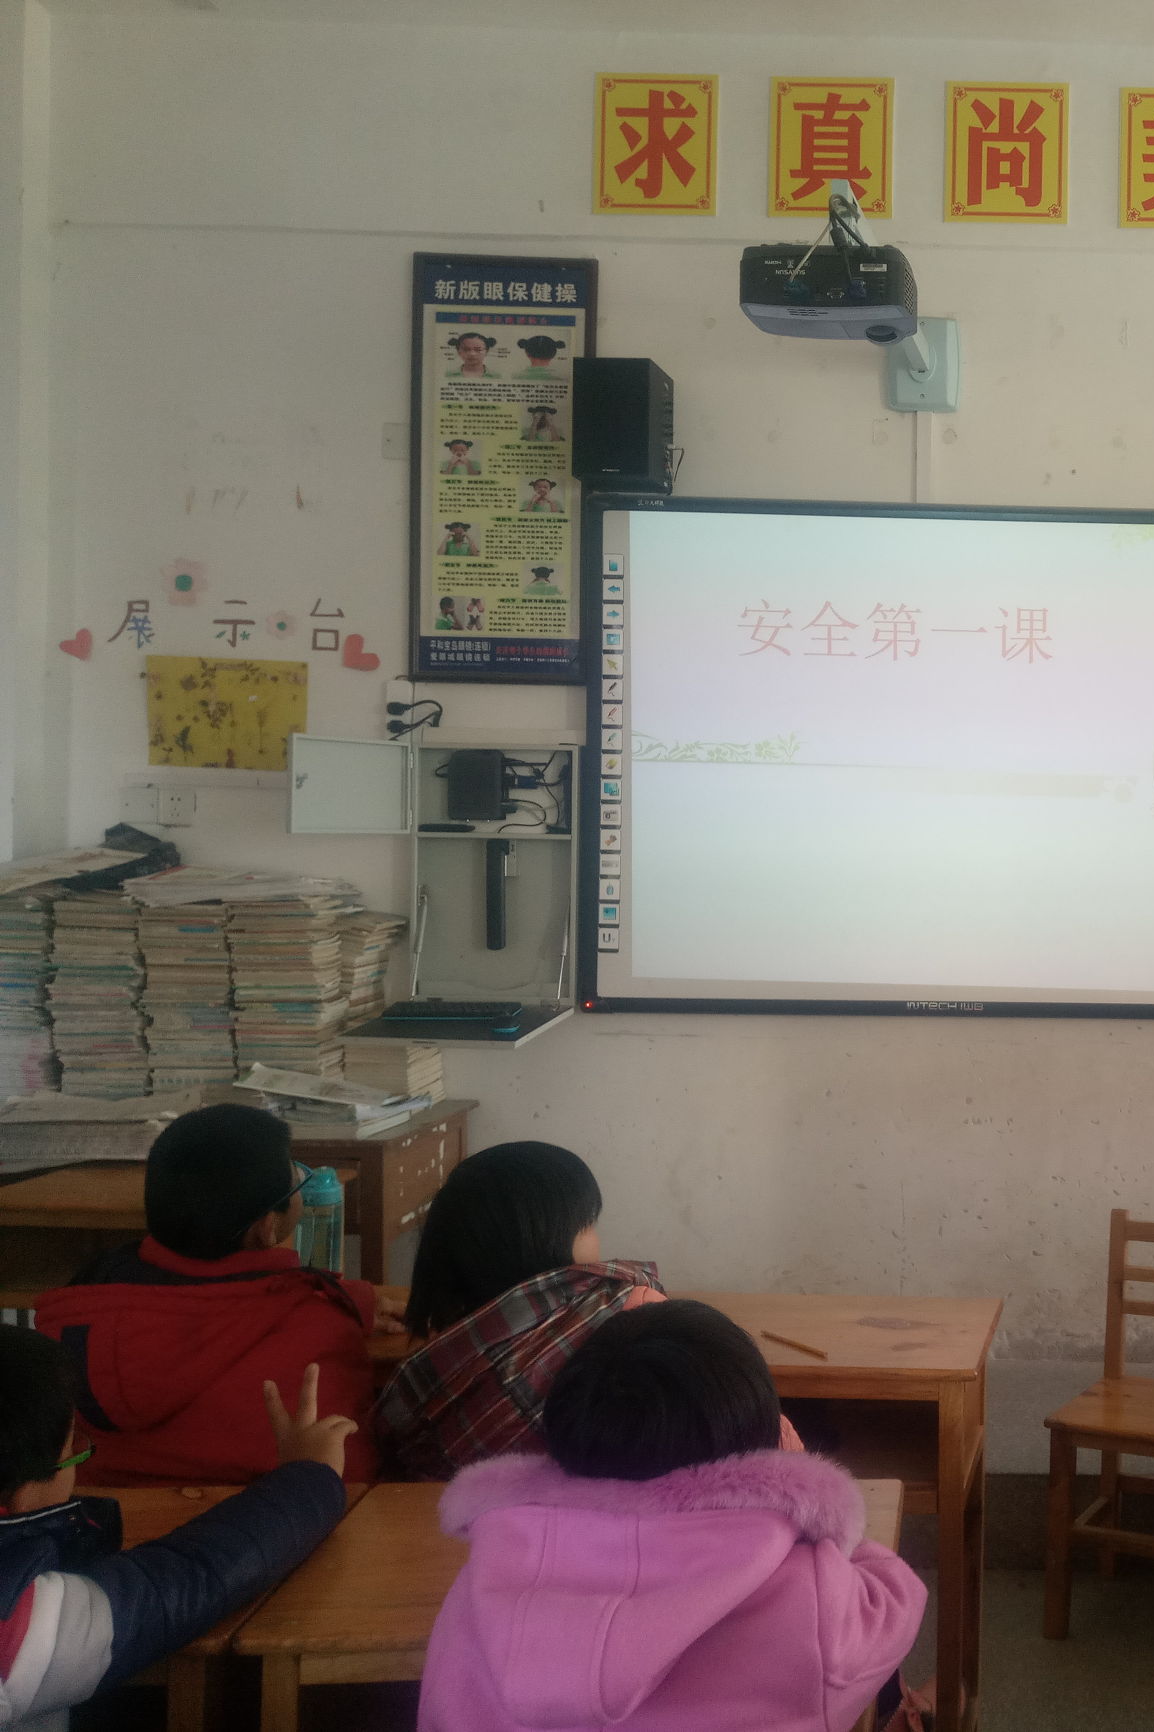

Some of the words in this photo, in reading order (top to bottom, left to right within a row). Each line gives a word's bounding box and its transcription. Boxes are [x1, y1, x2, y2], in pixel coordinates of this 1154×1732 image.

[434, 279, 578, 303] 新版眼保健操
[737, 599, 1054, 664] 安全第一课
